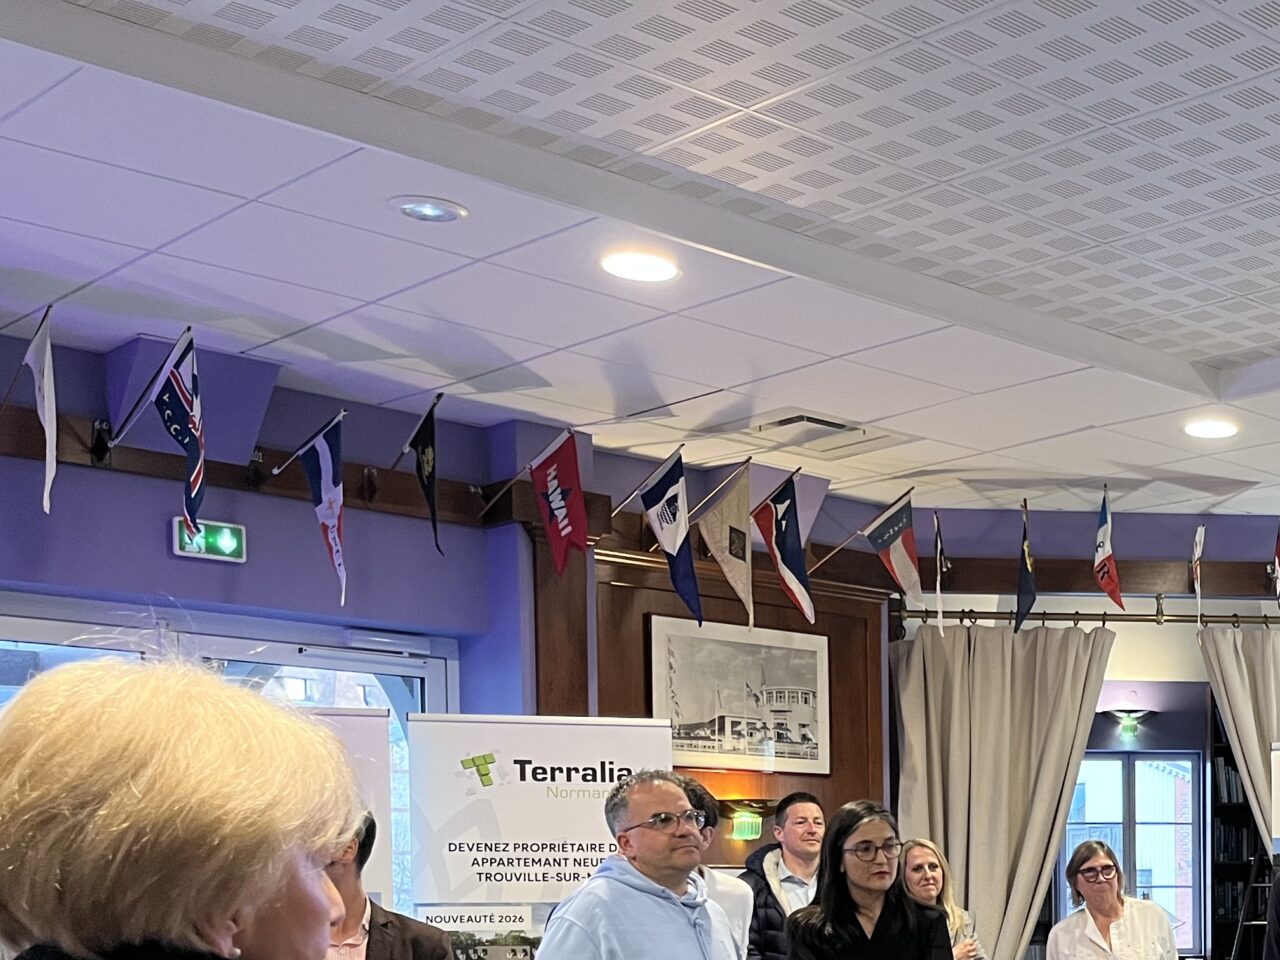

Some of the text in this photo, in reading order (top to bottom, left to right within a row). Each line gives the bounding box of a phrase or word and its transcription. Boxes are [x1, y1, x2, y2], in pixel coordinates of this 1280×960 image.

[546, 463, 573, 537] HAWAII
[513, 759, 633, 783] Terralia
[546, 786, 612, 799] Norman
[448, 840, 618, 853] DEVENEZ PROPRIÉTAIRE D
[471, 857, 570, 868] APPARTEMANT
[476, 872, 593, 882] TROUVILLE-SUR-
[425, 912, 525, 924] NOUVEAUTÉ 2026
